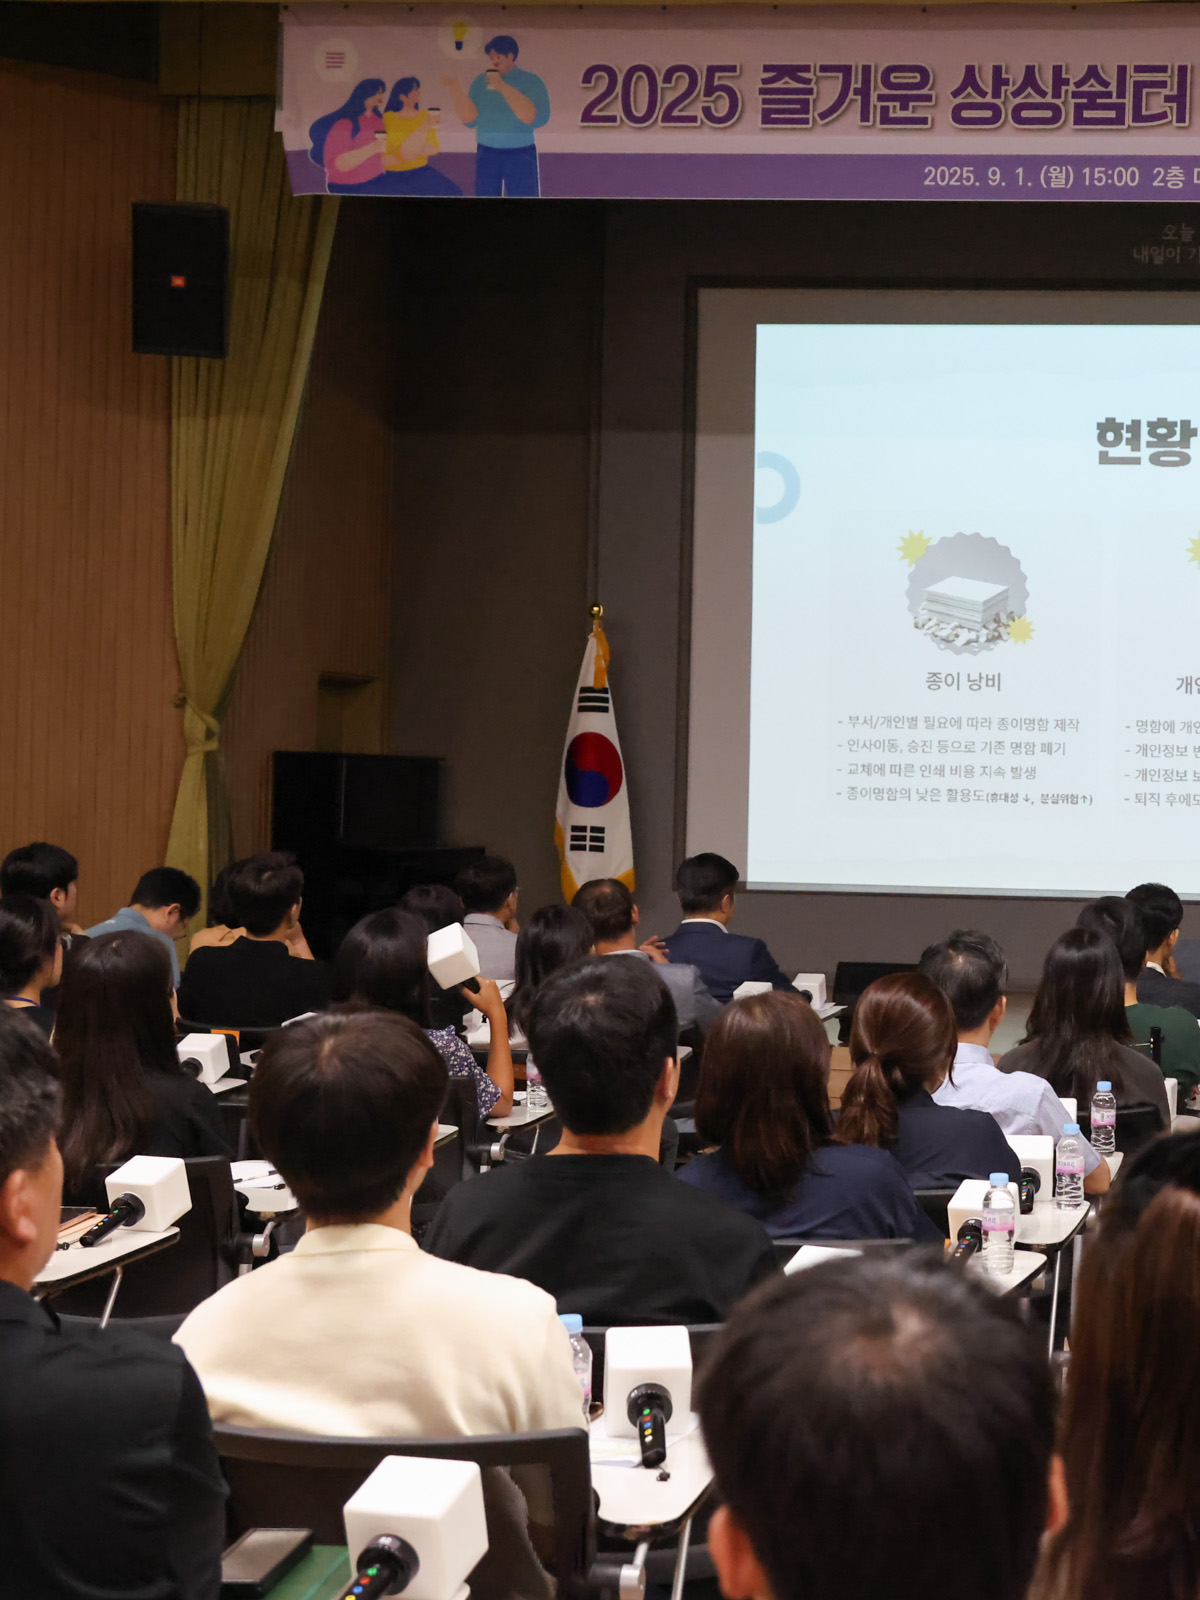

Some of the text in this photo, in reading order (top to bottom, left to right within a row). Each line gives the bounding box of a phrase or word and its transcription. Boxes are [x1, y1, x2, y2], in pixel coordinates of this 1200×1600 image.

[579, 62, 742, 126] 2025
[757, 62, 935, 128] 즐거운
[949, 62, 1190, 129] 상상쉼터
[923, 166, 979, 187] 2025.
[987, 166, 1005, 187] 9.
[1015, 166, 1032, 187] 1.
[1040, 165, 1074, 189] (월)
[1082, 166, 1140, 187] 15:00
[1152, 166, 1186, 189] 2층
[1162, 223, 1195, 242] 오늘
[1133, 245, 1181, 265] 내일이
[1096, 417, 1198, 467] 현황
[925, 671, 1002, 692] 종이 낭비
[847, 714, 1081, 733] 부서/개인별 필요에 따라 종이명함 제작
[1135, 719, 1176, 735] 명함에
[847, 738, 1066, 757] 인사이동, 승진 등으로 기존 명함 폐기
[1135, 743, 1189, 759] 개인정보
[847, 762, 1037, 781] 교체에 따른 인쇄 비용 지속 발생
[1134, 767, 1189, 783] 개인정보
[846, 786, 912, 803] 종이명함의
[915, 787, 942, 803] 낮은
[1134, 791, 1161, 807] 퇴직
